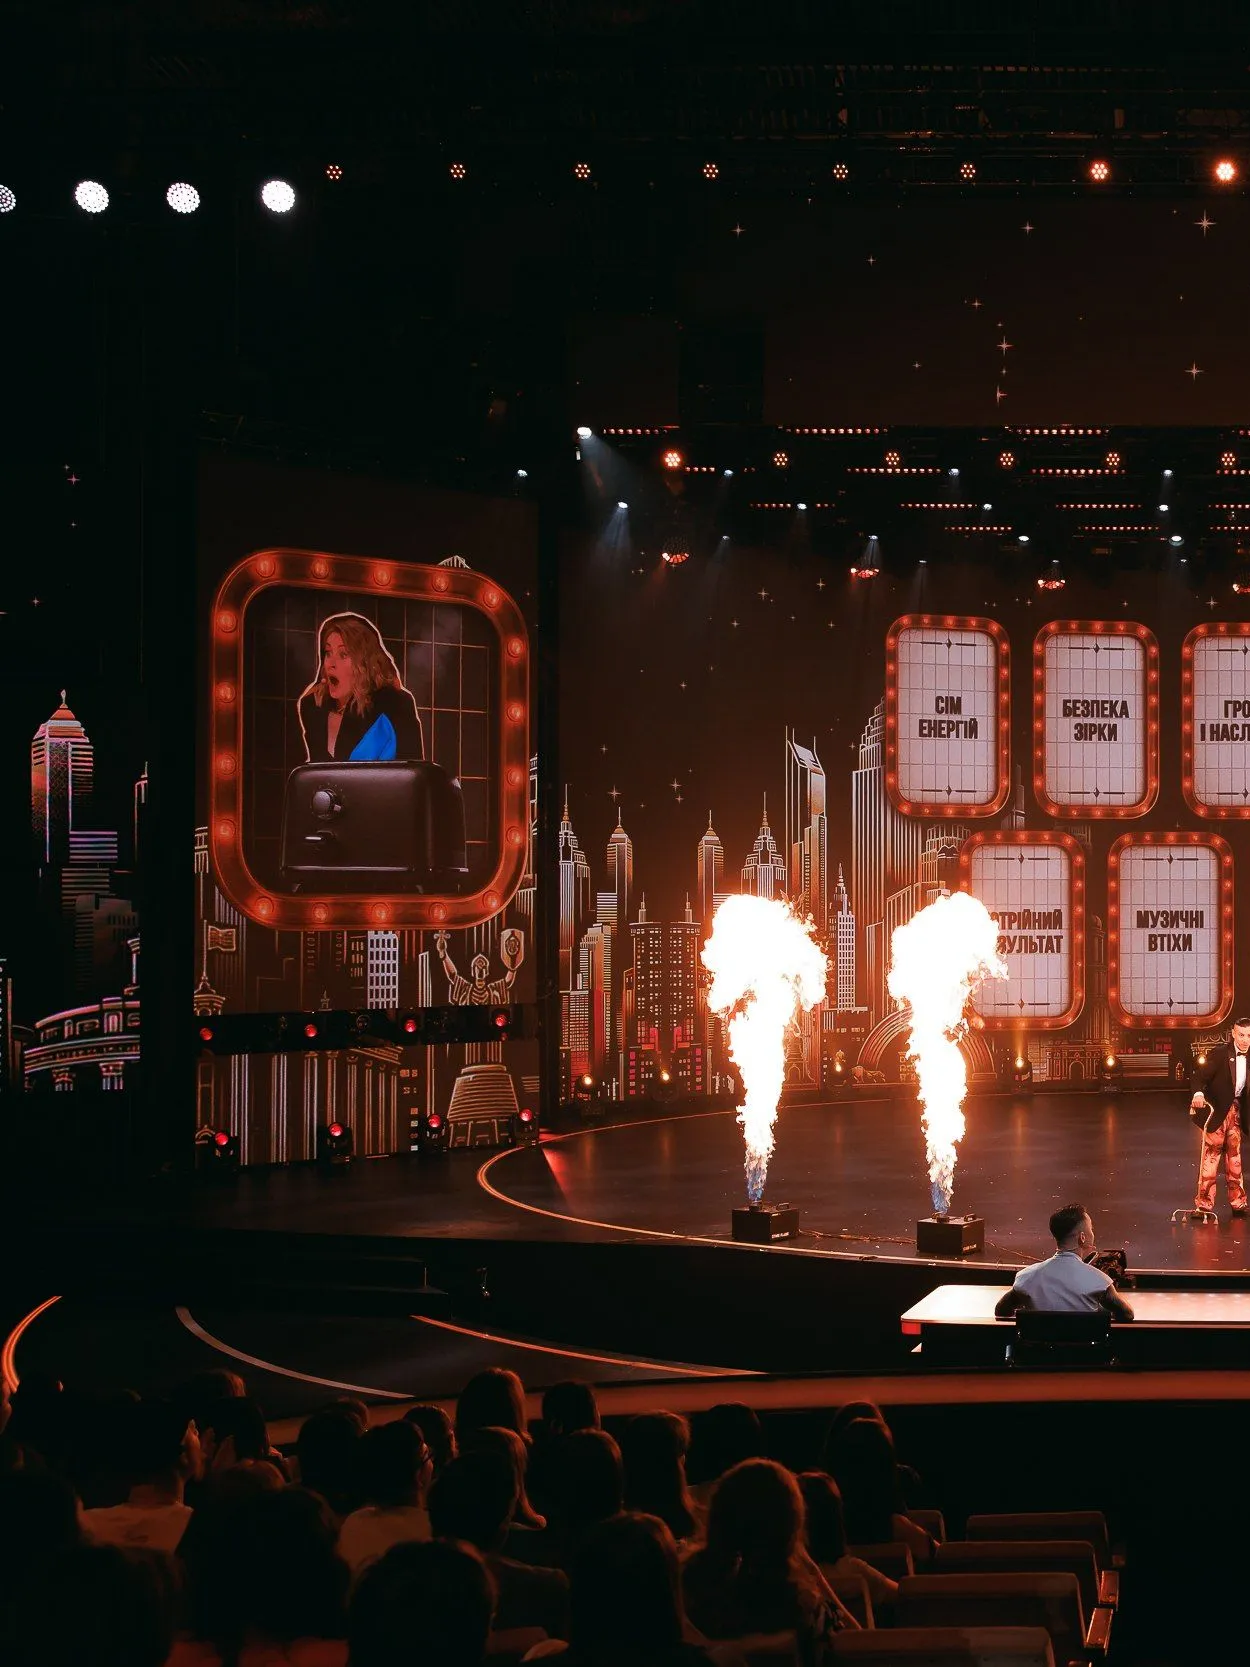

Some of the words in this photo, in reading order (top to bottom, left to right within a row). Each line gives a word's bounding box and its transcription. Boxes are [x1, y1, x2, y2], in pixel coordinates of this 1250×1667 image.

[935, 695, 962, 715] СІМ
[1062, 699, 1130, 719] БЕЗПЕКА
[918, 718, 978, 739] ЕНЕРГІЙ
[1073, 723, 1118, 742] ЗІРКИ
[1200, 723, 1206, 742] І
[990, 909, 1063, 930] ТРІЙНИЙ
[1136, 910, 1204, 929] МУЗИЧНІ
[996, 935, 1064, 954] ЗУЛЬТАТ
[1148, 933, 1193, 952] ВТІХИ
